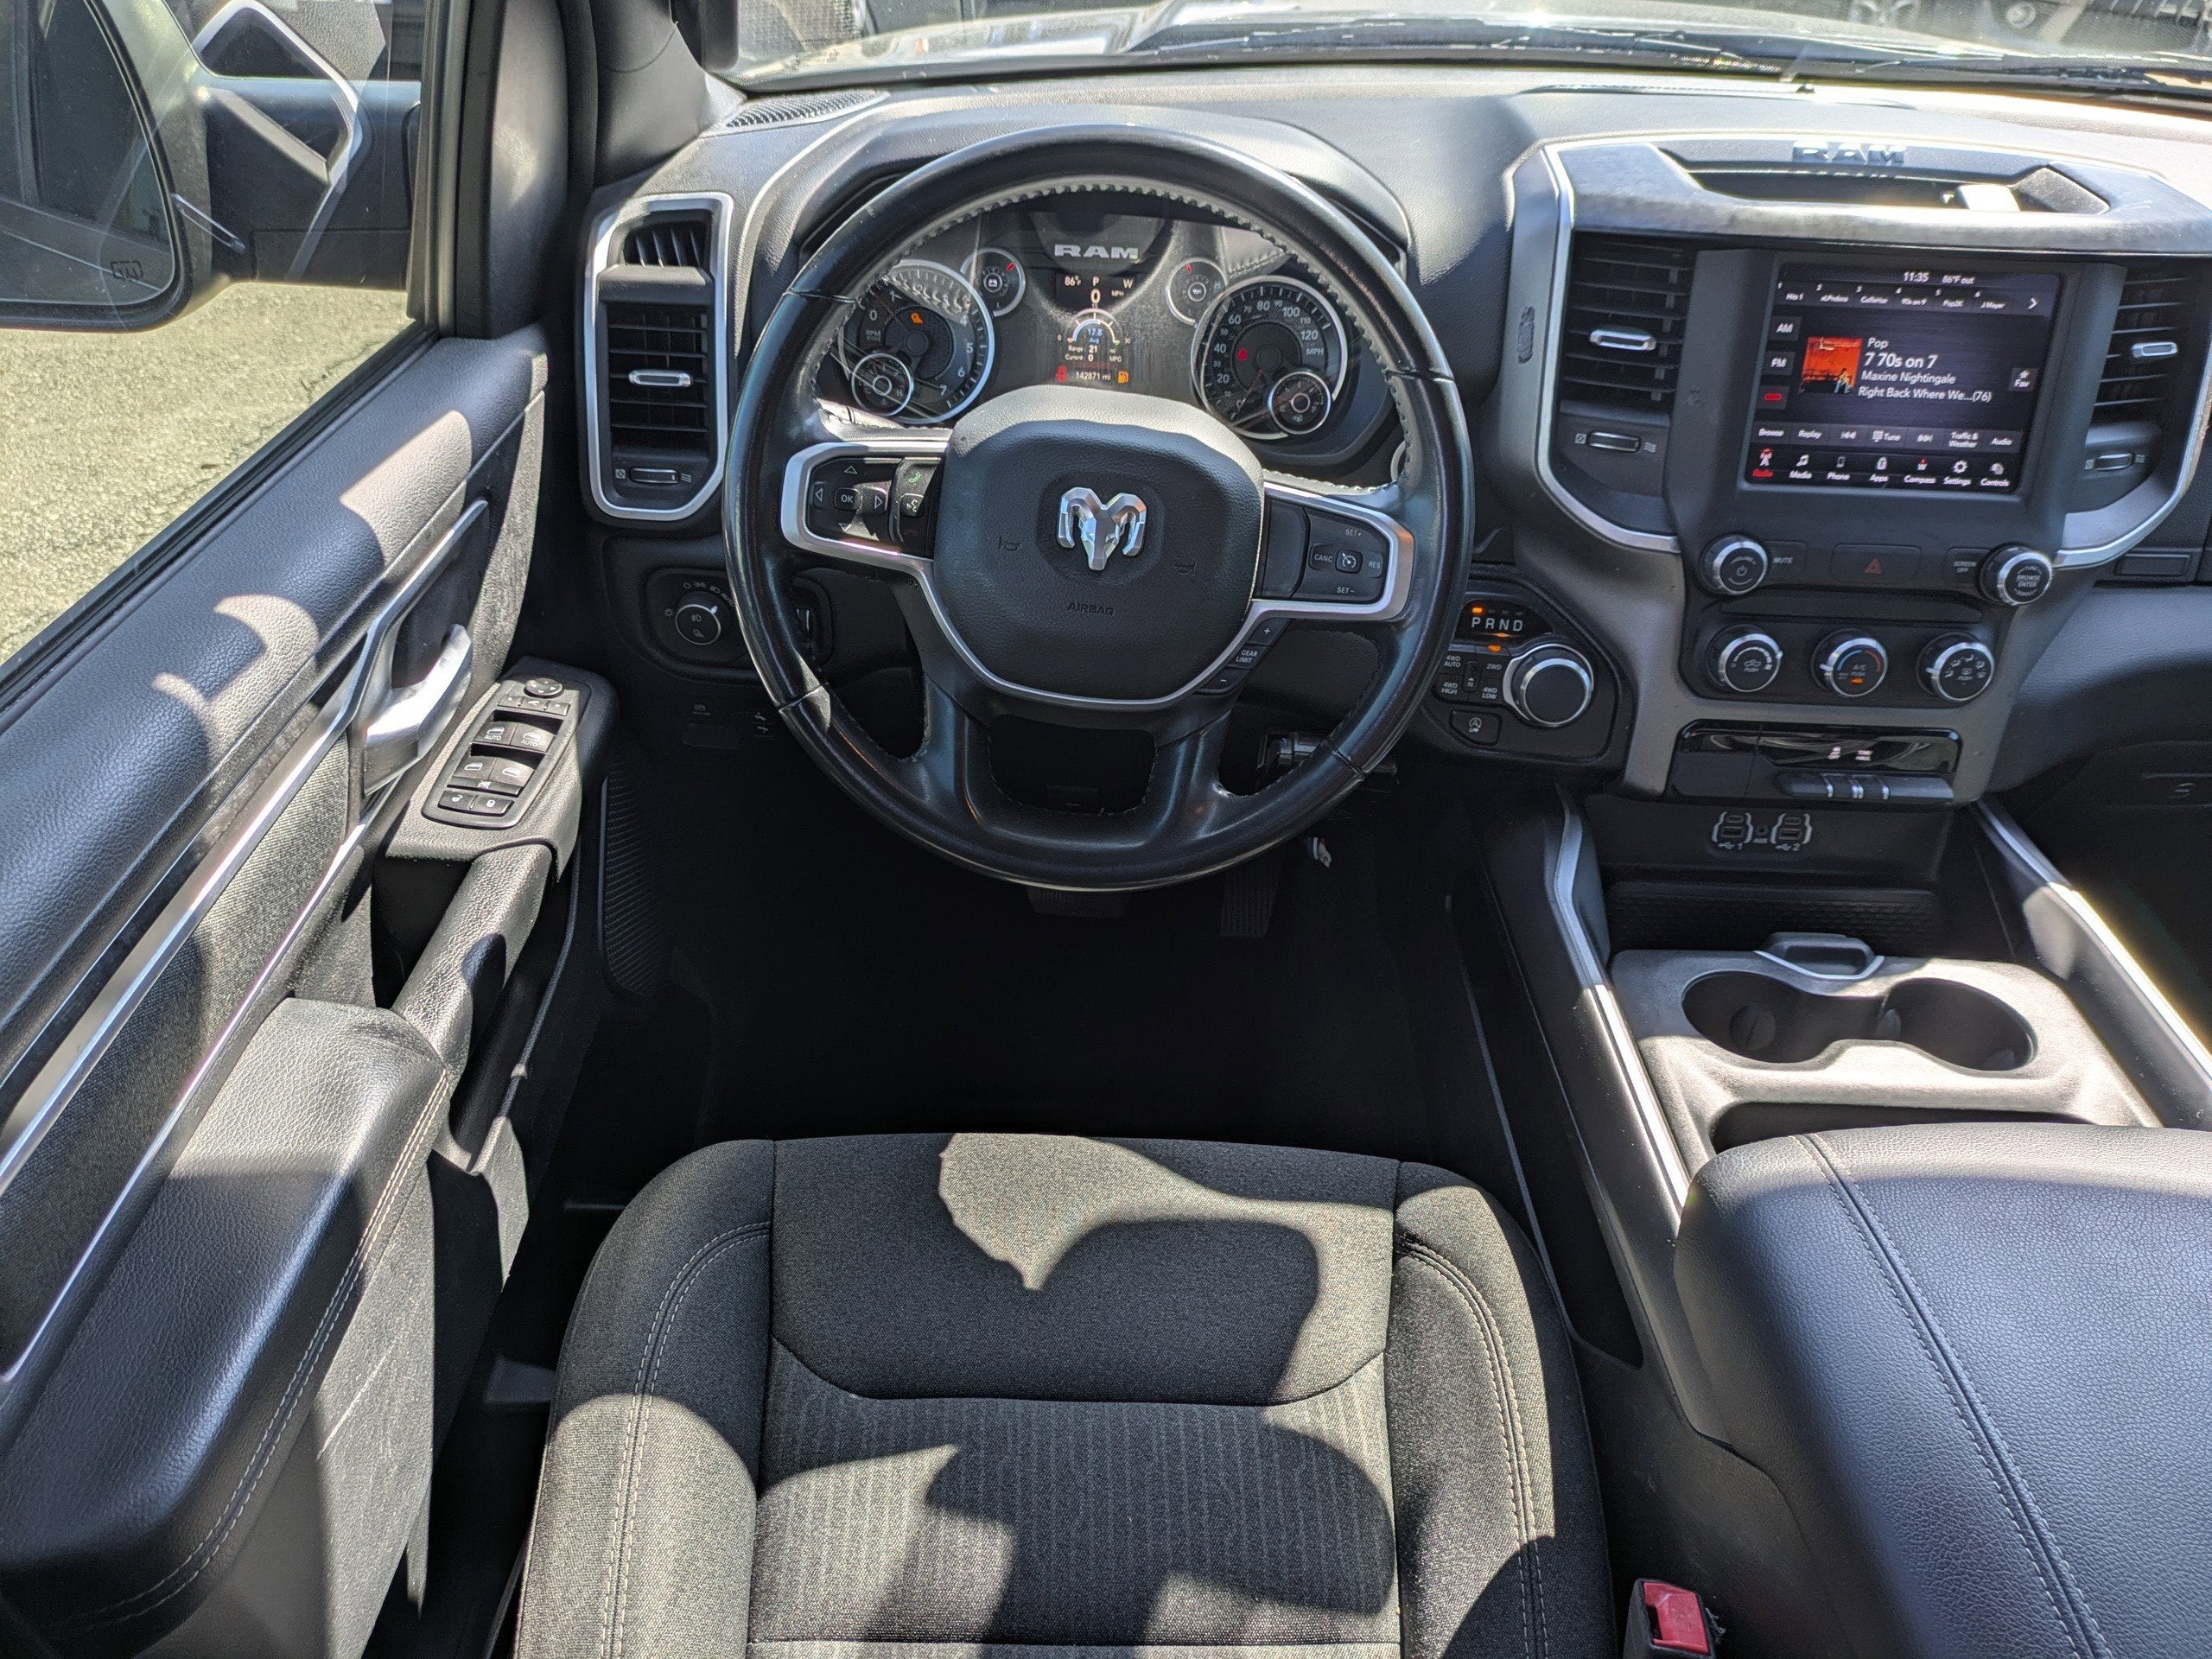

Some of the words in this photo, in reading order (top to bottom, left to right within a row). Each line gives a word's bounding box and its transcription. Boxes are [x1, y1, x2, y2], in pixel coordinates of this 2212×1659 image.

[1792, 140, 1906, 166] RAM
[1054, 245, 1139, 259] RAM
[1092, 276, 1100, 287] P
[1903, 271, 1929, 283] 11:35
[1123, 279, 1133, 289] W
[1090, 289, 1101, 304] 0
[1256, 301, 1270, 311] 80
[868, 309, 878, 321] 0
[1282, 307, 1300, 317] 100
[960, 315, 968, 327] 4
[1229, 315, 1242, 325] 60
[1776, 322, 1794, 333] AM
[1300, 329, 1319, 340] 120
[966, 342, 974, 354] 5
[1214, 343, 1227, 353] 40
[1867, 337, 1889, 350] Pop
[1089, 345, 1098, 354] 21
[1306, 347, 1324, 356] MPH
[1770, 357, 1787, 368] FM
[1864, 352, 1876, 366] 7
[1877, 352, 1903, 368] 70s
[1905, 357, 1924, 368] on
[1927, 354, 1939, 369] 7
[957, 366, 965, 378] 6
[1076, 372, 1100, 380] 142871
[1217, 373, 1230, 384] 20
[1860, 370, 1898, 382] Maxine
[1899, 371, 1956, 385] Nightingale
[2014, 378, 2031, 387] Fav
[1858, 385, 1885, 398] Right
[1886, 387, 1911, 398] Back
[1912, 387, 1945, 399] Where
[1758, 428, 1784, 437] Browse
[1797, 429, 1822, 439] Replay
[1884, 433, 1901, 442] Tune
[1991, 437, 2012, 446] Audio
[1789, 470, 1813, 479] Media
[1827, 471, 1850, 480] Phone
[1869, 474, 1889, 482] Apps
[1904, 475, 1936, 484] Compass
[1943, 477, 1972, 486] Settings
[1980, 478, 2010, 486] Controls
[841, 494, 854, 503] OK
[1314, 554, 1333, 563] CANC
[1368, 561, 1381, 569] RES
[1067, 602, 1116, 616] AIRBAG
